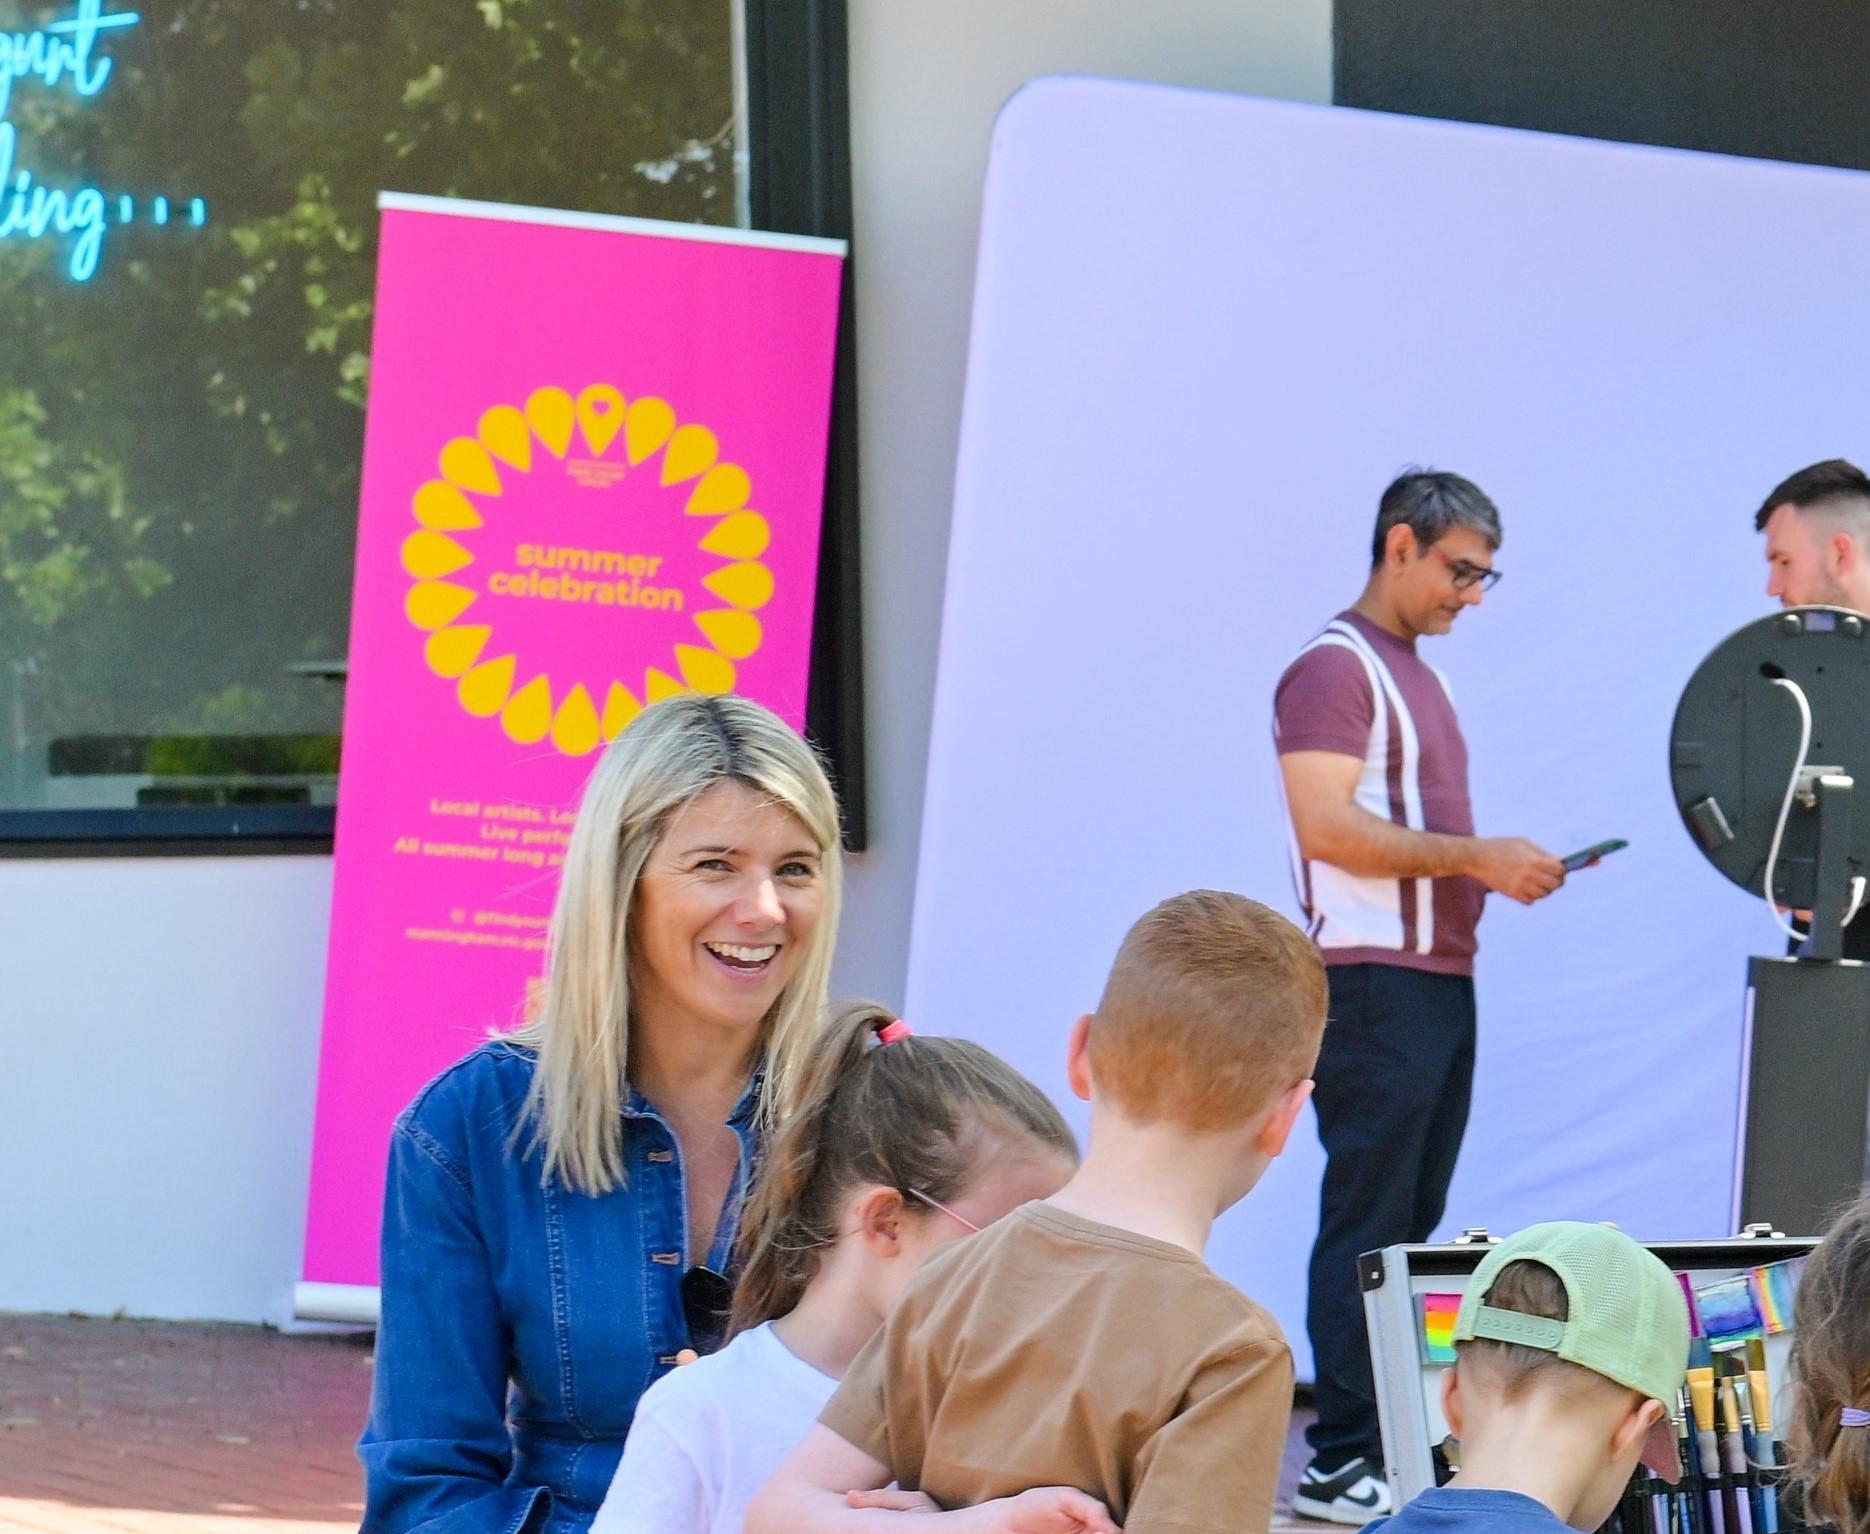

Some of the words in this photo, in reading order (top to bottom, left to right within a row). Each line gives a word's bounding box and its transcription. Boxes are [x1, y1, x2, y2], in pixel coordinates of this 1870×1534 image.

[516, 543, 662, 578] summer
[488, 569, 685, 612] celebration
[430, 798, 480, 817] Local
